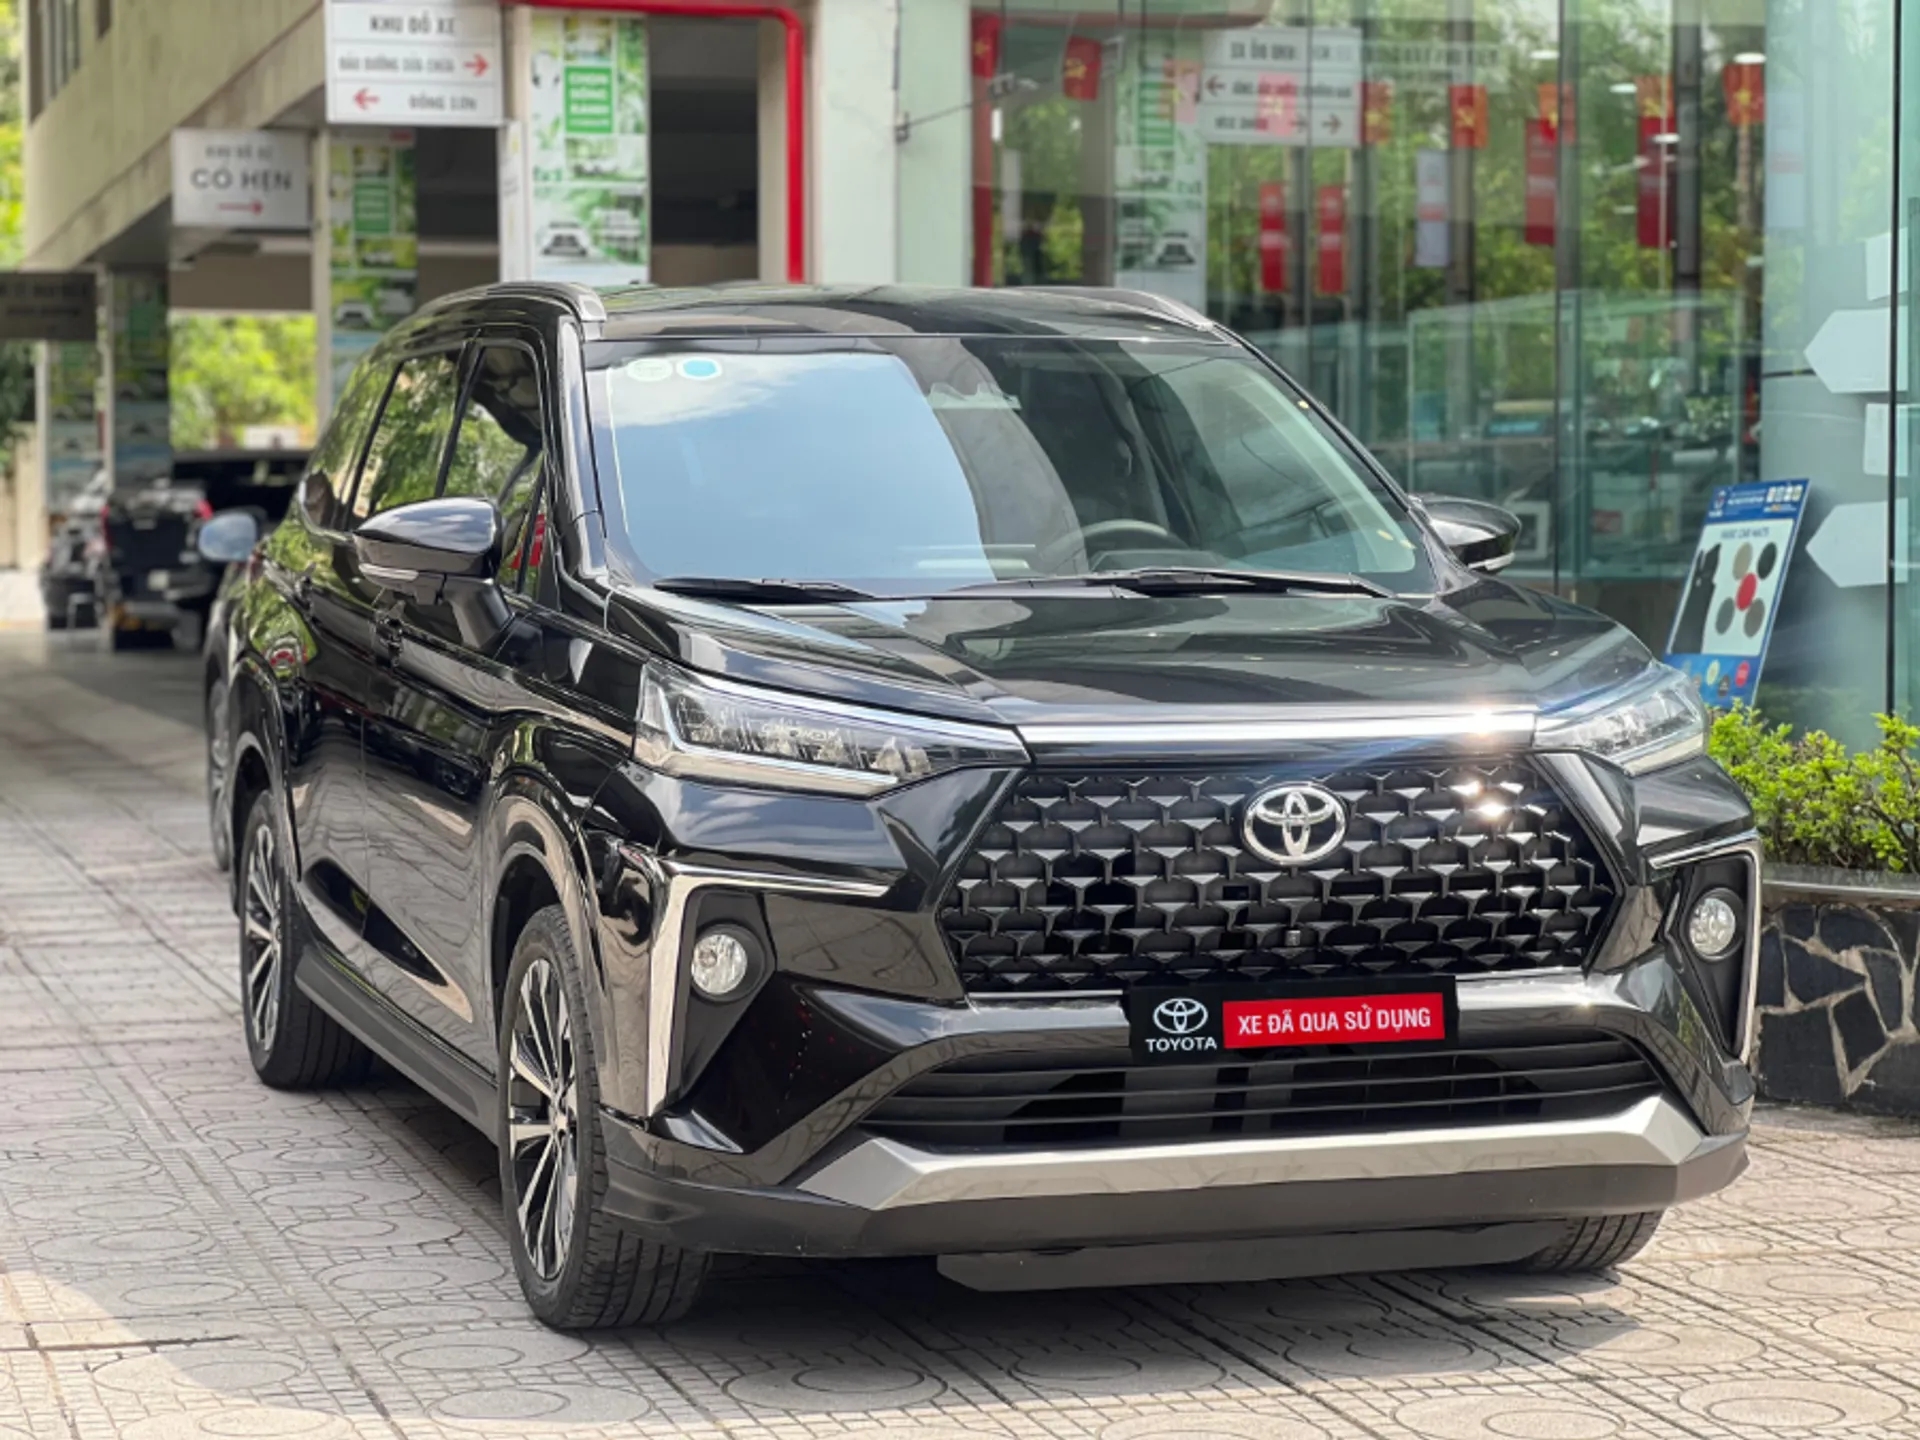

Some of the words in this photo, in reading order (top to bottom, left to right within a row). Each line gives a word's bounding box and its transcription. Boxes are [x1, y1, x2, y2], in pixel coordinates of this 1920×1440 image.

[370, 16, 403, 33] KHU
[1238, 1015, 1262, 1036] XE
[1267, 1009, 1294, 1034] ĐÃ
[1300, 1011, 1340, 1033] QUA
[1344, 1003, 1373, 1030] SỬ
[1376, 1007, 1431, 1033] DỤNG
[1145, 1036, 1218, 1053] TOYOTA
